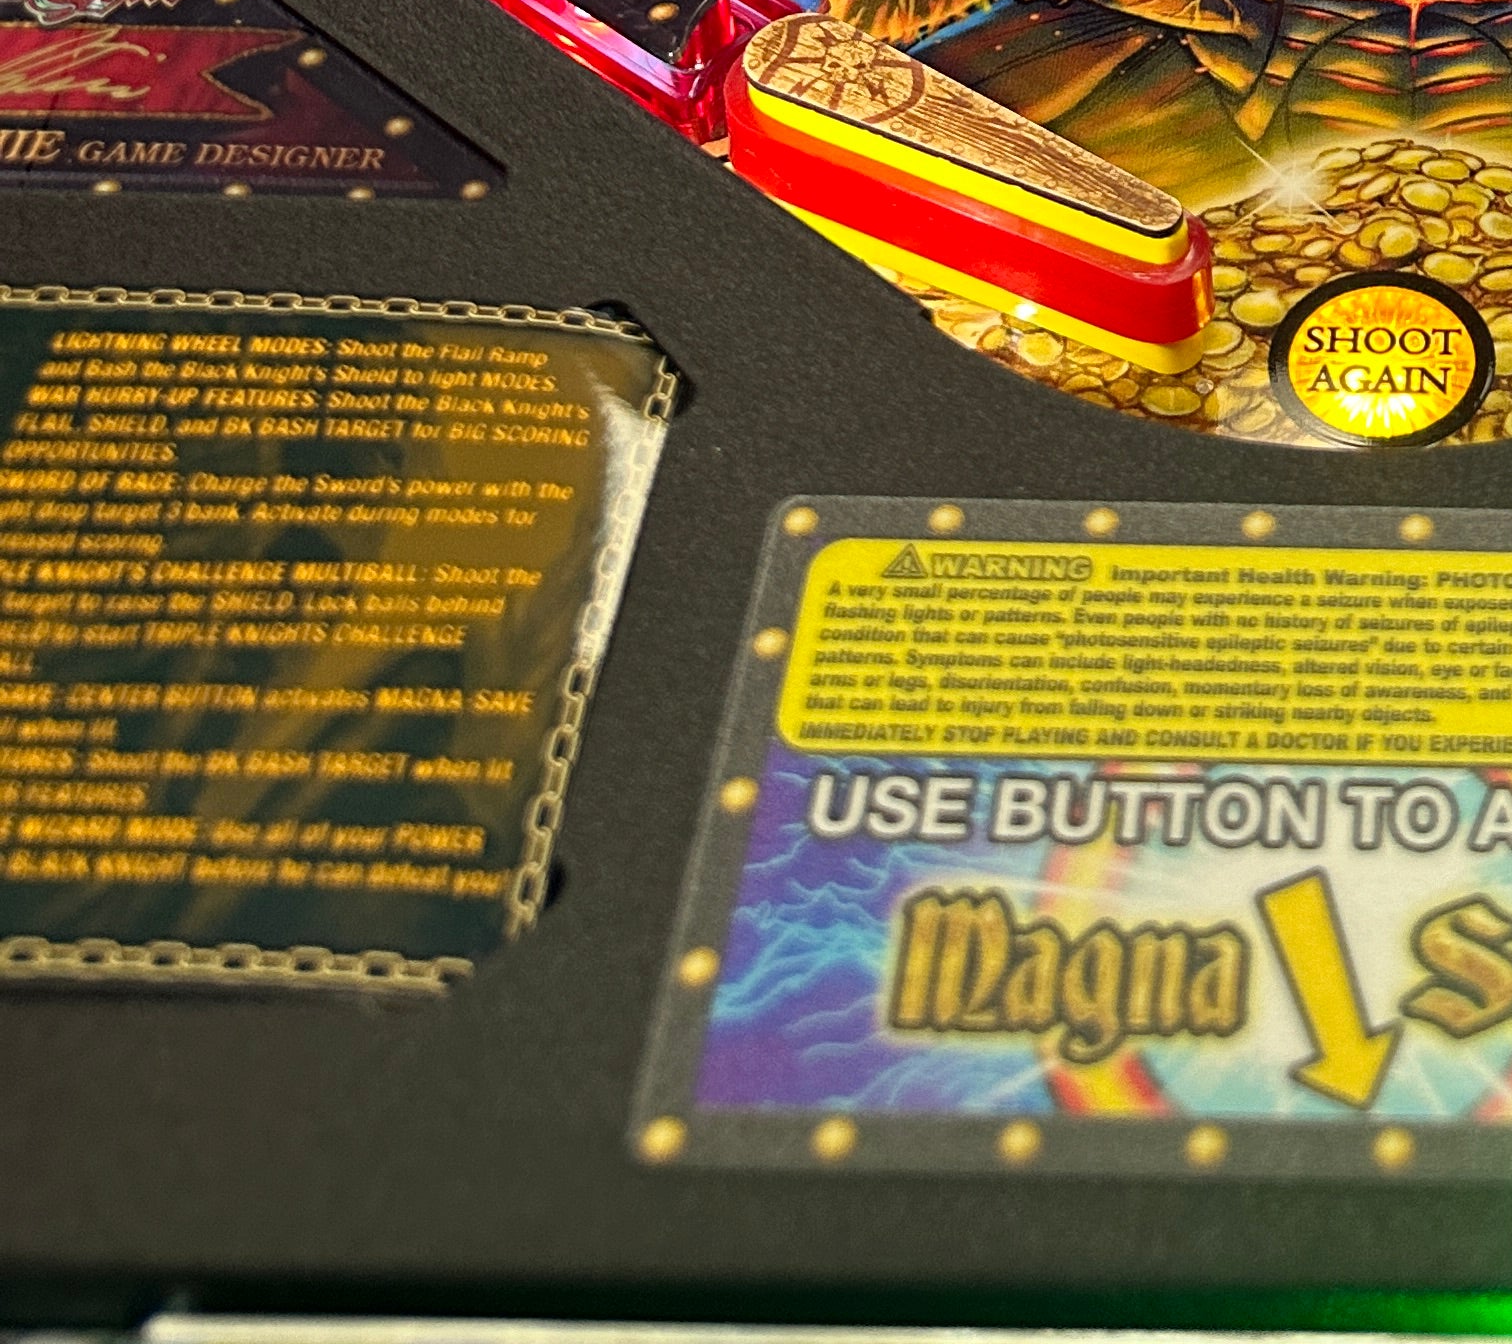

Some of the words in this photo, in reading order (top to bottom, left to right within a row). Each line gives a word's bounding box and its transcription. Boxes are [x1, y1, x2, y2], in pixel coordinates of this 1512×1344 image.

[77, 140, 188, 165] GAME
[195, 142, 386, 170] DESIGNER
[52, 331, 168, 354] LIGHTNING
[169, 333, 242, 355] WHEEL
[337, 338, 397, 358] Shoot
[402, 342, 434, 360] the
[438, 343, 485, 362] Flail
[488, 346, 549, 368] Ramp
[1303, 325, 1463, 356] SHOOT
[37, 360, 84, 379] and
[84, 358, 137, 380] Bash
[141, 360, 177, 380] the
[179, 360, 238, 381] Black
[242, 362, 327, 386] Knight's
[333, 364, 399, 386] Shield
[402, 368, 424, 386] to
[428, 370, 477, 390] light
[1307, 364, 1452, 394] AGAIN
[27, 383, 83, 406] WAR
[327, 390, 392, 411] Shoot
[395, 393, 430, 412] the
[434, 394, 496, 415] Black
[501, 398, 591, 421] Knight's
[174, 415, 220, 437] and
[256, 416, 319, 439] BASH
[324, 417, 408, 440] TARGET
[411, 420, 443, 440] for
[448, 422, 489, 442] BIG
[490, 423, 592, 448] SCORING
[187, 470, 268, 496] Charge
[272, 474, 309, 495] the
[313, 472, 402, 497] Sword's
[405, 478, 478, 498] power
[481, 479, 532, 499] with
[537, 480, 576, 502] the
[929, 552, 1093, 582] WARNING
[1111, 564, 1230, 589] Important
[1238, 566, 1315, 587] Health
[1323, 568, 1428, 593] Warning:
[826, 582, 843, 597] A
[847, 586, 887, 602] very
[892, 583, 943, 599] small
[946, 584, 1053, 606] percentage
[1057, 587, 1078, 602] of
[1082, 587, 1144, 607] people
[1148, 593, 1187, 608] may
[1192, 589, 1296, 611] experience
[1300, 596, 1313, 607] a
[1316, 592, 1384, 608] seizure
[1388, 593, 1440, 610] when
[822, 605, 898, 625] flashing
[902, 607, 955, 627] lights
[959, 612, 979, 623] or
[983, 608, 1069, 629] patterns.
[1072, 610, 1118, 626] Even
[1122, 611, 1186, 631] people
[1191, 612, 1232, 628] with
[1236, 617, 1259, 629] no
[1264, 614, 1329, 634] history
[1334, 615, 1355, 631] of
[1358, 616, 1436, 632] seizures
[798, 719, 935, 743] IMMEDIATELY
[942, 722, 996, 744] STOP
[1001, 724, 1090, 746] PLAYING
[1094, 725, 1137, 747] AND
[1145, 726, 1241, 749] CONSULT
[1246, 729, 1259, 750] A
[1265, 729, 1349, 752] DOCTOR
[1355, 731, 1373, 752] IF
[1382, 731, 1422, 753] YOU
[806, 769, 972, 842] USE
[989, 776, 1323, 851] BUTTON
[1343, 783, 1456, 852] TO
[885, 882, 1253, 1065] Magna
